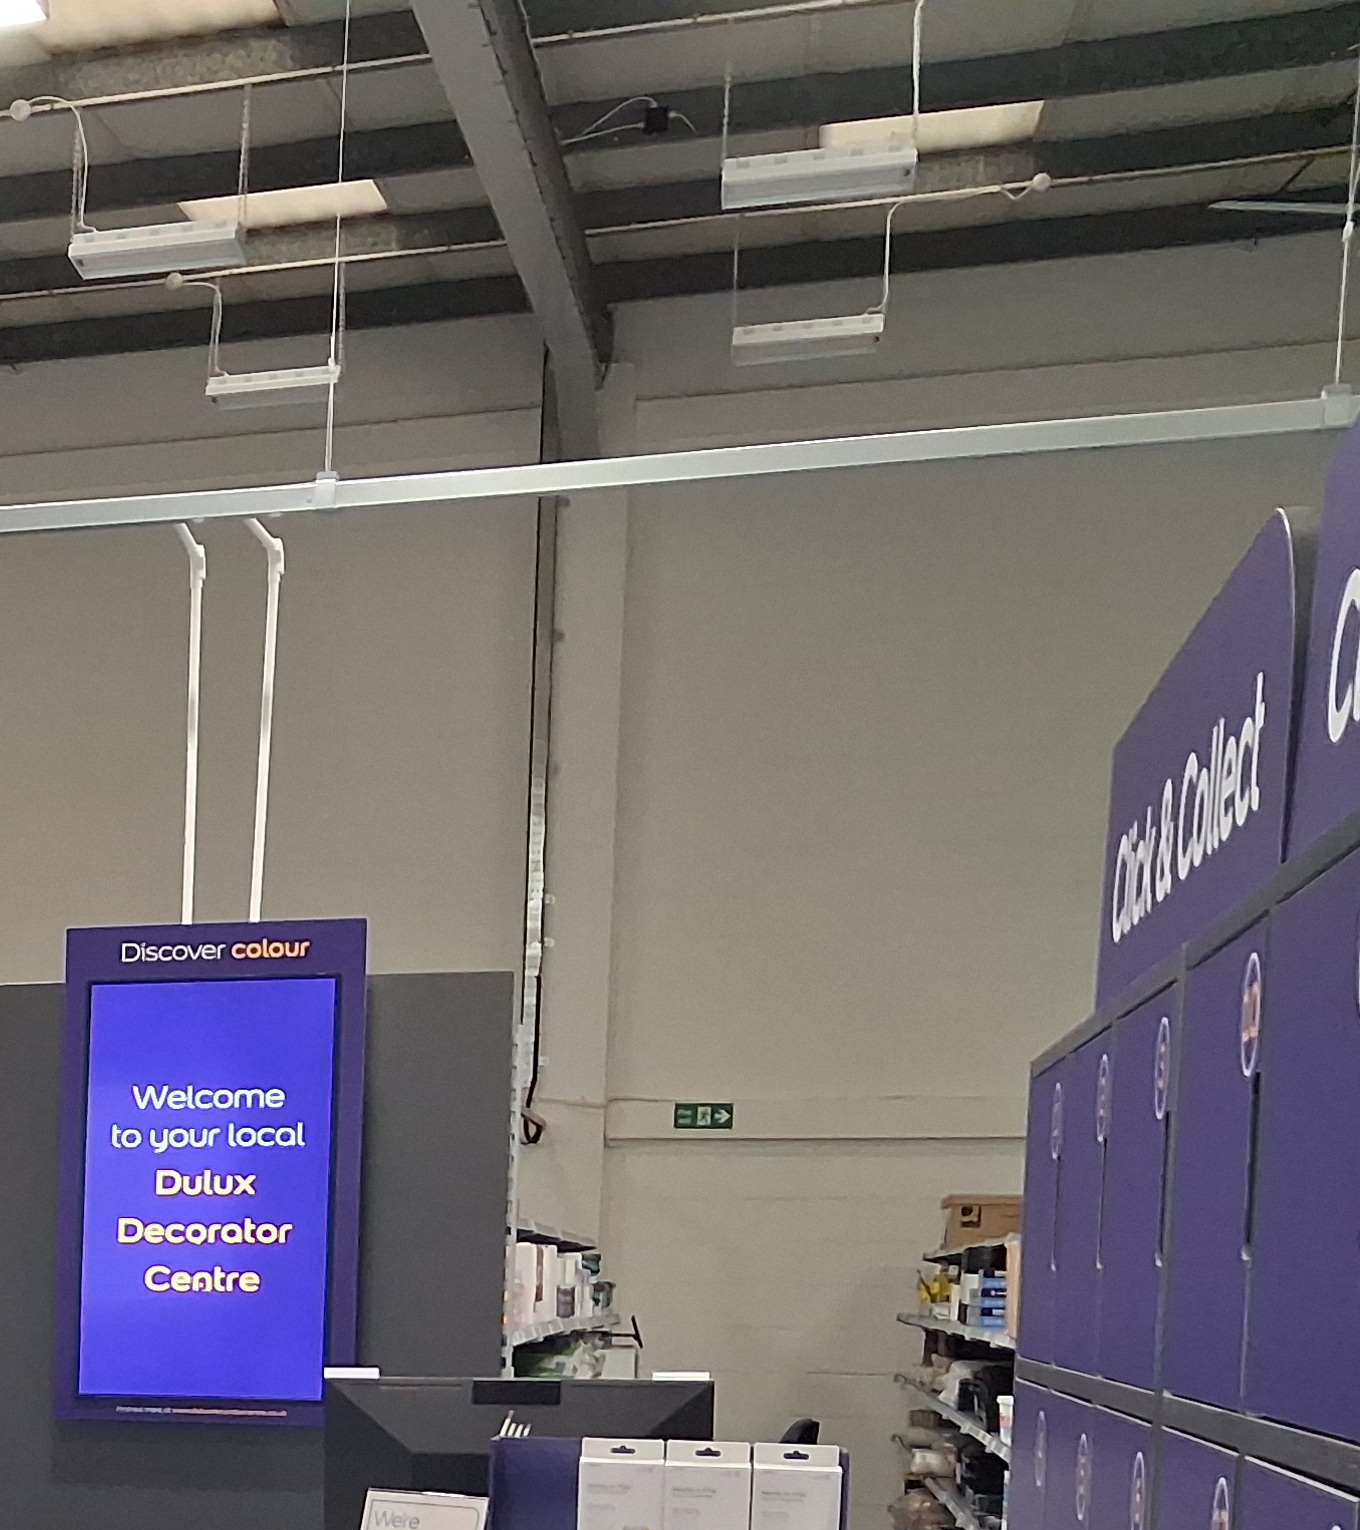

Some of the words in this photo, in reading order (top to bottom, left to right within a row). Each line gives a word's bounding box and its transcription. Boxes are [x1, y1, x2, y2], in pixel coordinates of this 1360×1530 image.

[1113, 807, 1156, 942] Click
[1156, 779, 1174, 902] &
[1177, 672, 1264, 880] Collect
[120, 940, 226, 963] Discover
[230, 939, 311, 960] colour
[132, 1085, 286, 1110] Welcome
[111, 1123, 142, 1149] to
[149, 1126, 221, 1154] your
[227, 1121, 306, 1148] local
[154, 1169, 257, 1197] Dulux
[116, 1217, 294, 1246] Decorator
[144, 1265, 262, 1294] Centre
